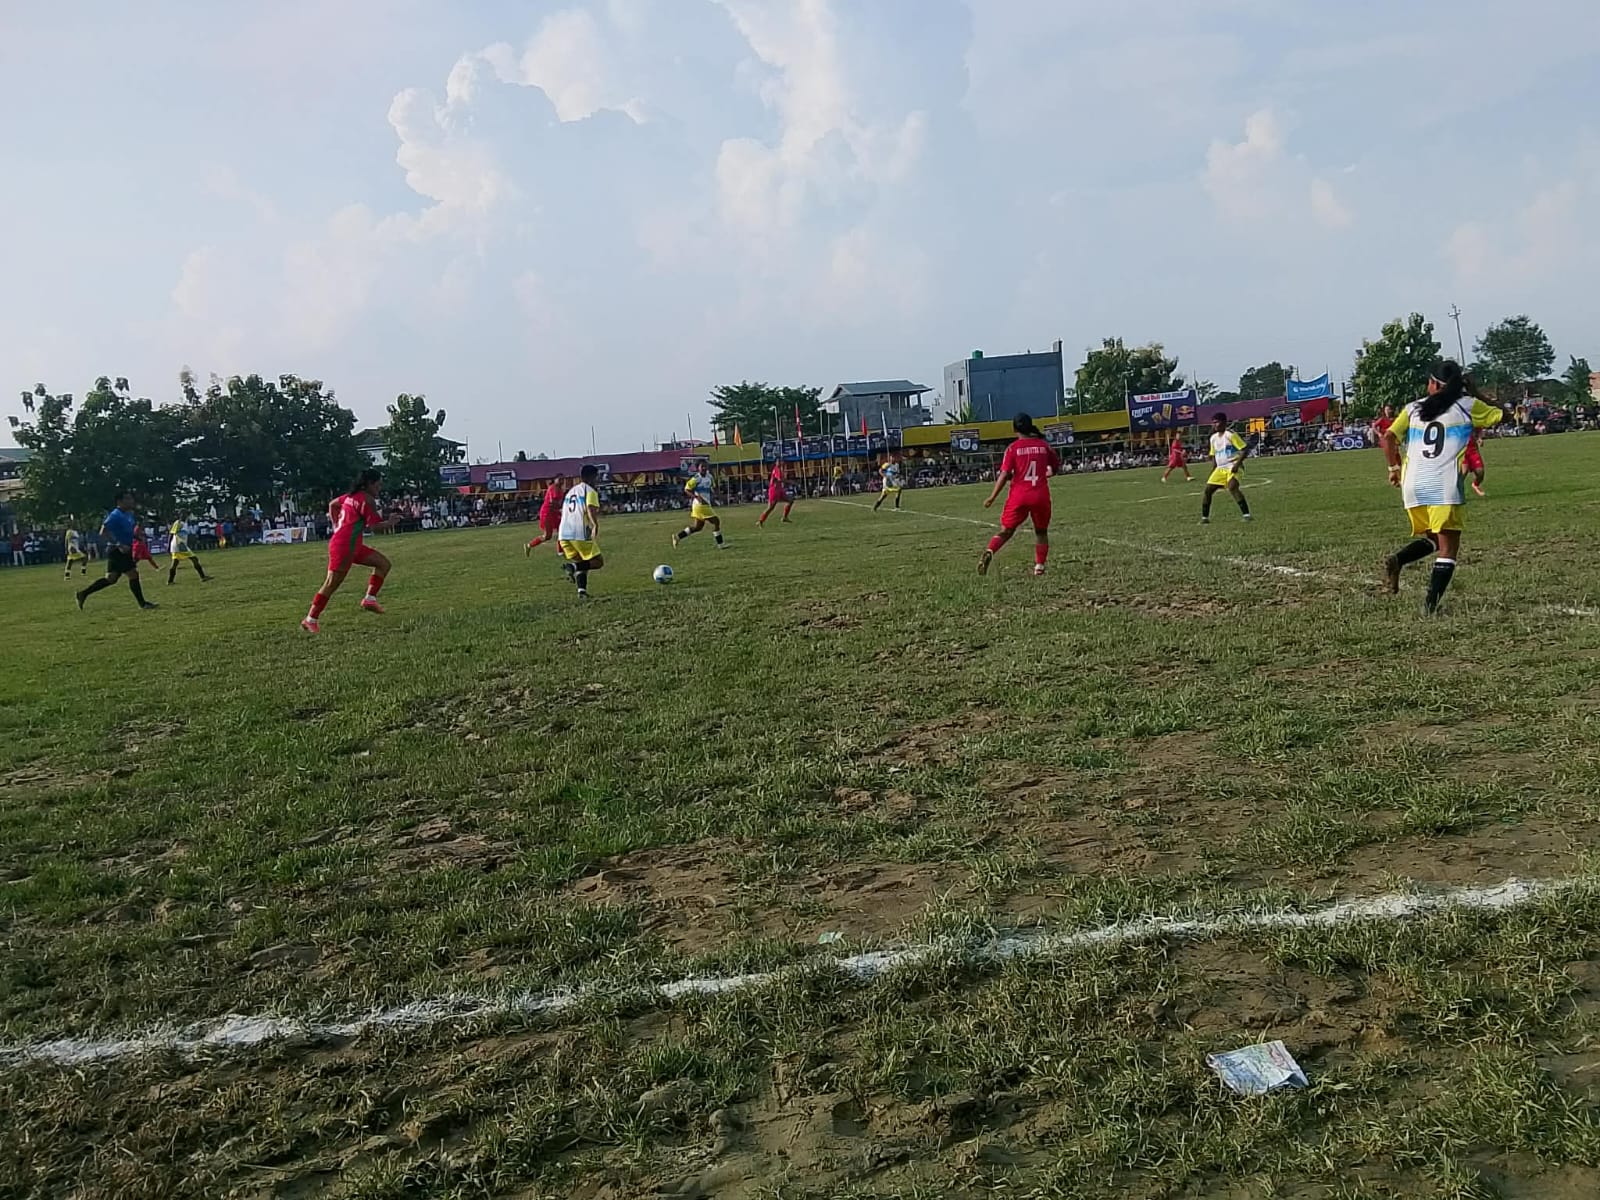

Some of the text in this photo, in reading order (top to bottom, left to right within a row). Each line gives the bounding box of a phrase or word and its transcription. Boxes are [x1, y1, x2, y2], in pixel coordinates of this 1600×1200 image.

[1422, 421, 1445, 459] 9
[1024, 460, 1039, 487] 4
[569, 494, 577, 513] 5
